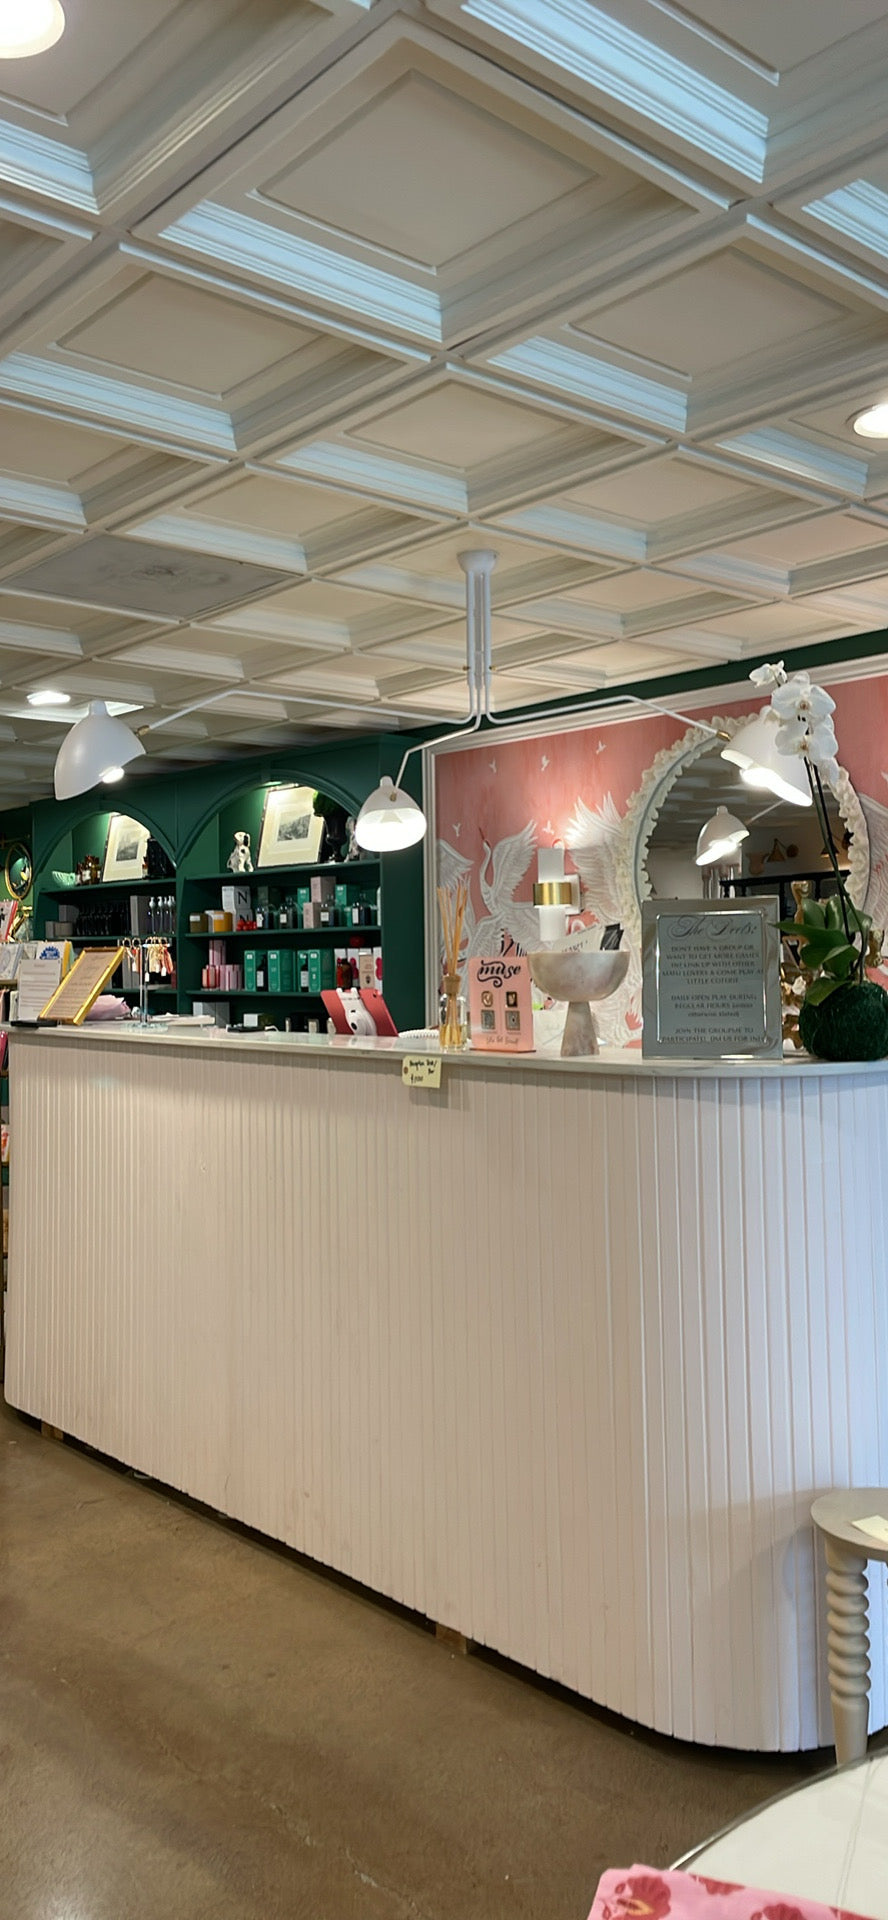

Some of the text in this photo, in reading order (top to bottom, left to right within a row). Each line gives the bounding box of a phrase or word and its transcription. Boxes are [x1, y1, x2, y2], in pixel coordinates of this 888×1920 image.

[238, 890, 248, 905] N
[667, 915, 706, 940] The
[477, 960, 521, 988] muse
